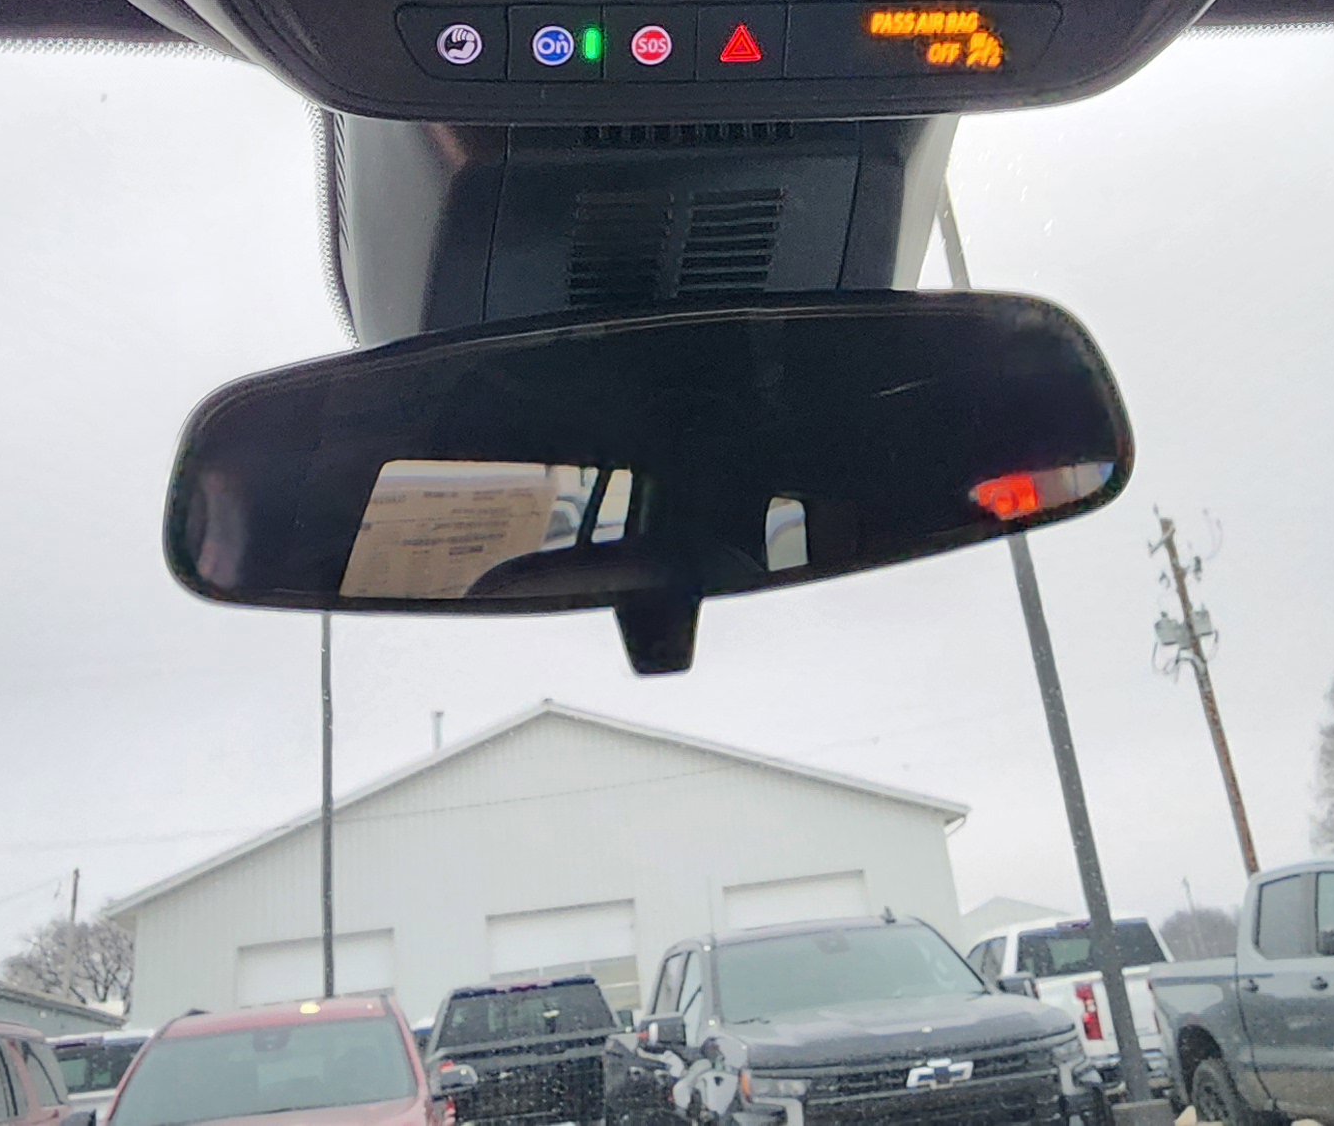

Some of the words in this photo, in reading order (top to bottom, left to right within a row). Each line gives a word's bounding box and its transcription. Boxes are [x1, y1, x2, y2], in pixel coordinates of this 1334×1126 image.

[870, 10, 916, 35] PASS
[914, 10, 946, 35] AIR
[537, 35, 569, 55] On
[636, 37, 667, 54] SOS
[927, 41, 961, 65] OFF
